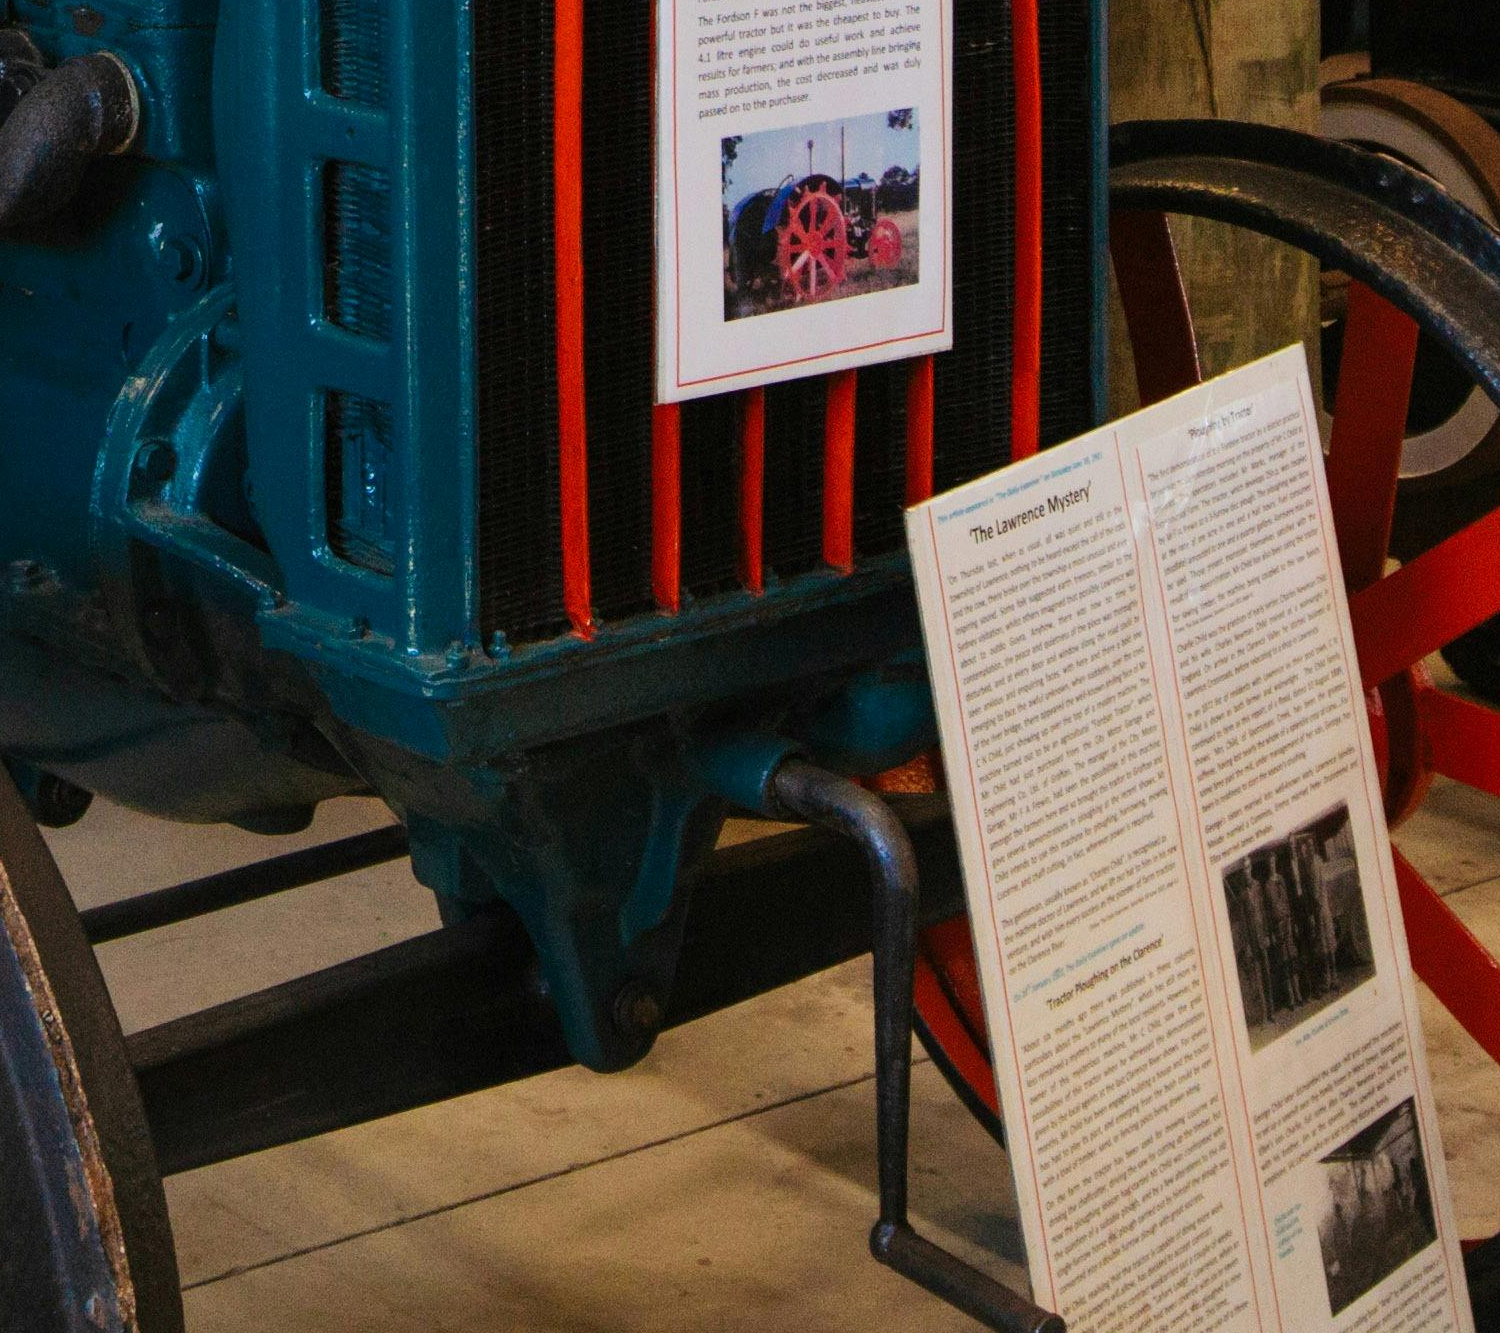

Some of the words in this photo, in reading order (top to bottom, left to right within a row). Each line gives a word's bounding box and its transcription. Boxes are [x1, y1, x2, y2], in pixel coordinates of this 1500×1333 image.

[697, 15, 713, 26] The
[716, 11, 750, 23] Fordson
[762, 8, 778, 17] was
[781, 4, 795, 14] not
[799, 2, 812, 12] the
[698, 30, 735, 47] powerful
[738, 27, 766, 39] tractor
[770, 24, 784, 35] but
[797, 21, 812, 30] was
[815, 17, 829, 27] the
[832, 12, 868, 25] cheapest
[872, 11, 881, 19] to
[905, 5, 920, 14] The
